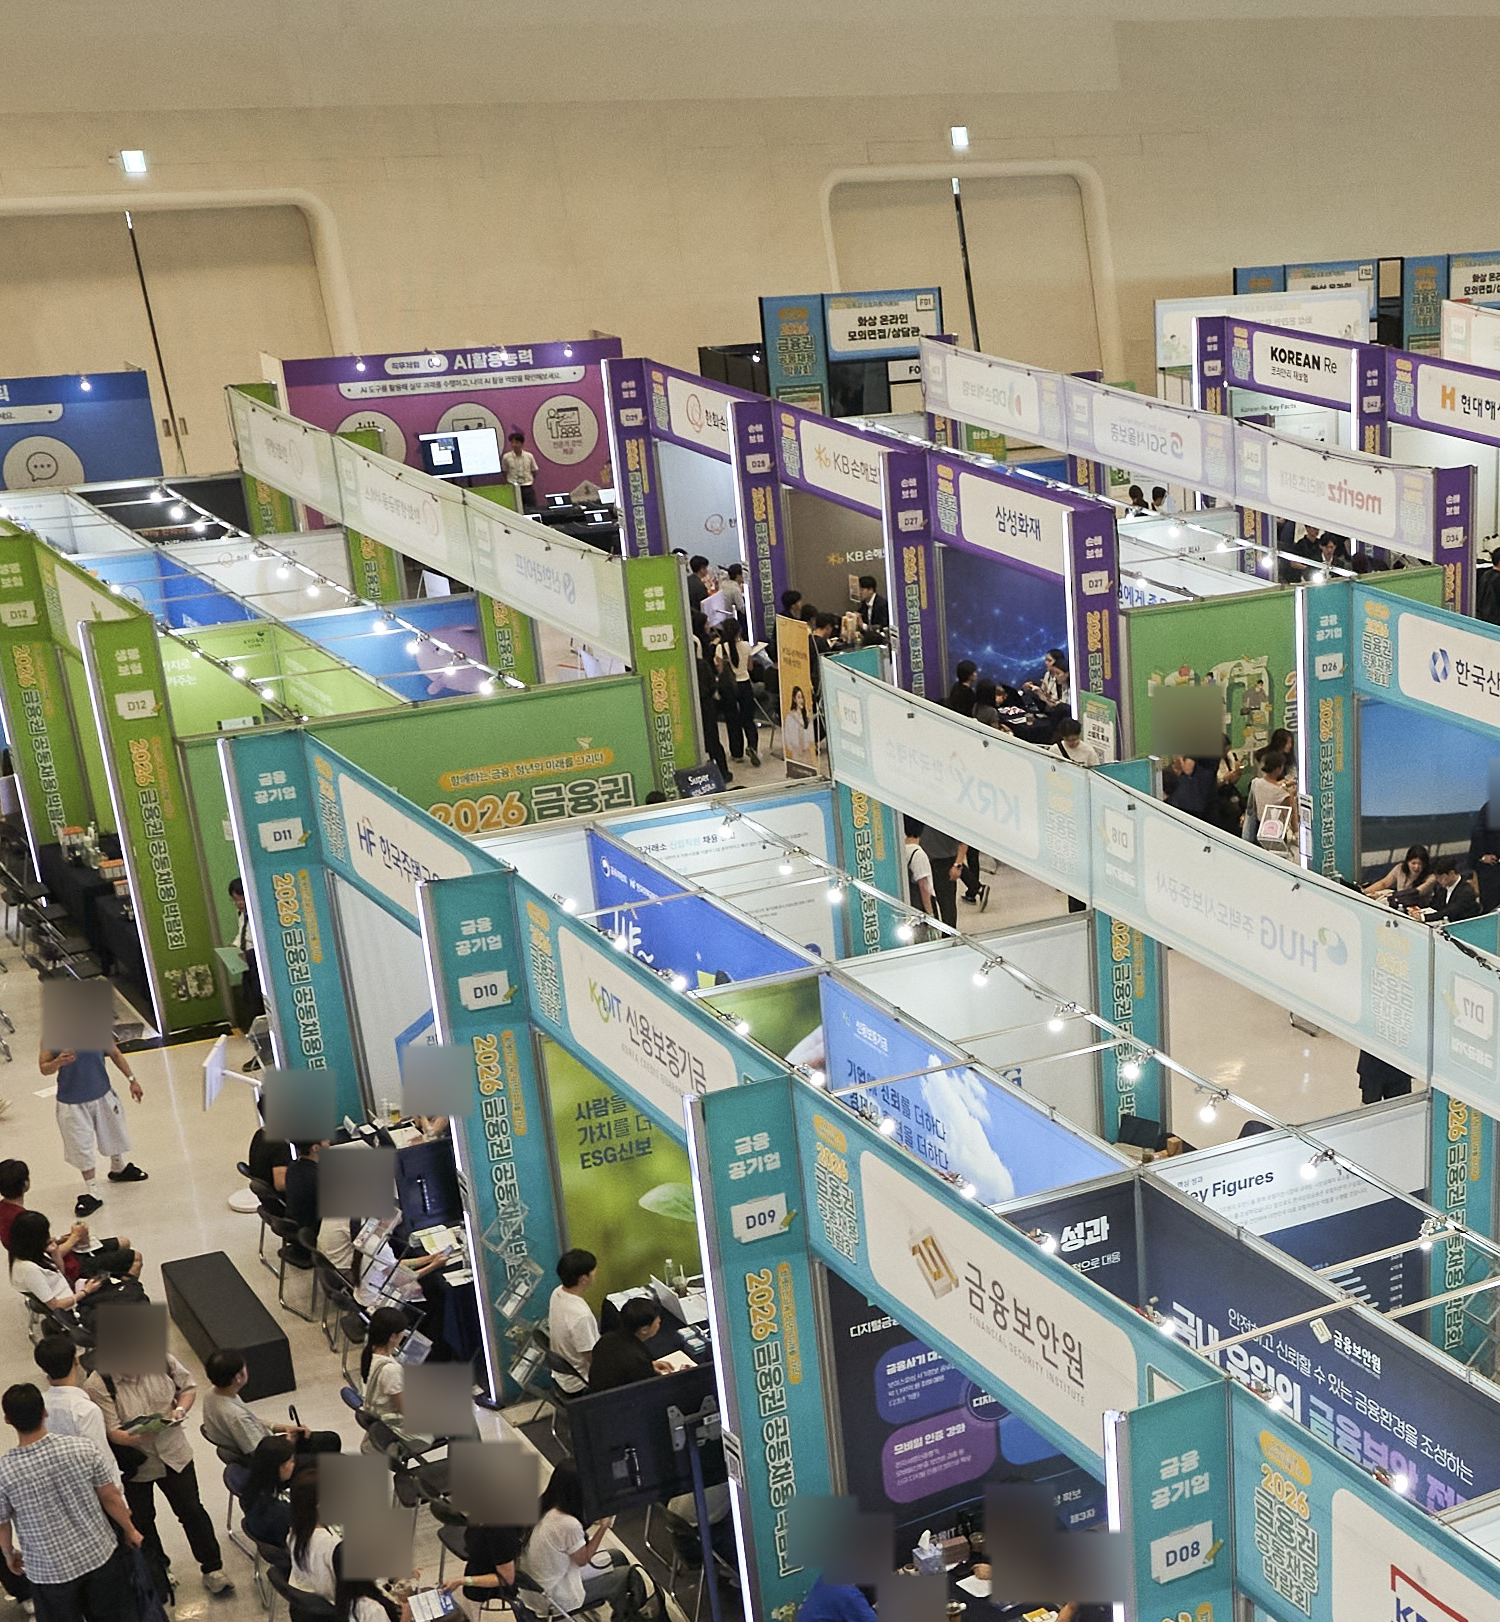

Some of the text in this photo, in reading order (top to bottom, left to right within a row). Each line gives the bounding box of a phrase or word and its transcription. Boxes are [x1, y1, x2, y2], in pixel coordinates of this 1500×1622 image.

[847, 325, 920, 341] 모의면접/상담관
[1270, 347, 1337, 373] KOREAN Re
[995, 505, 1042, 543] 삼성화재
[431, 774, 634, 833] 2026 금융권
[272, 829, 294, 844] D11
[473, 984, 498, 999] D10
[627, 1011, 707, 1093] 신용보증기금
[581, 1139, 652, 1168] ESG신보
[734, 1132, 769, 1159] 금융
[729, 1152, 783, 1183] 공기업
[1212, 1169, 1274, 1199] Figures
[746, 1210, 775, 1231] D09
[1061, 1216, 1109, 1252] 성과
[965, 1261, 1085, 1389] 금융보안원
[1333, 1330, 1382, 1371] 금융보안원
[1276, 1339, 1474, 1485] 신뢰할 금융환경을 조성하는
[1164, 1539, 1204, 1567] D08
